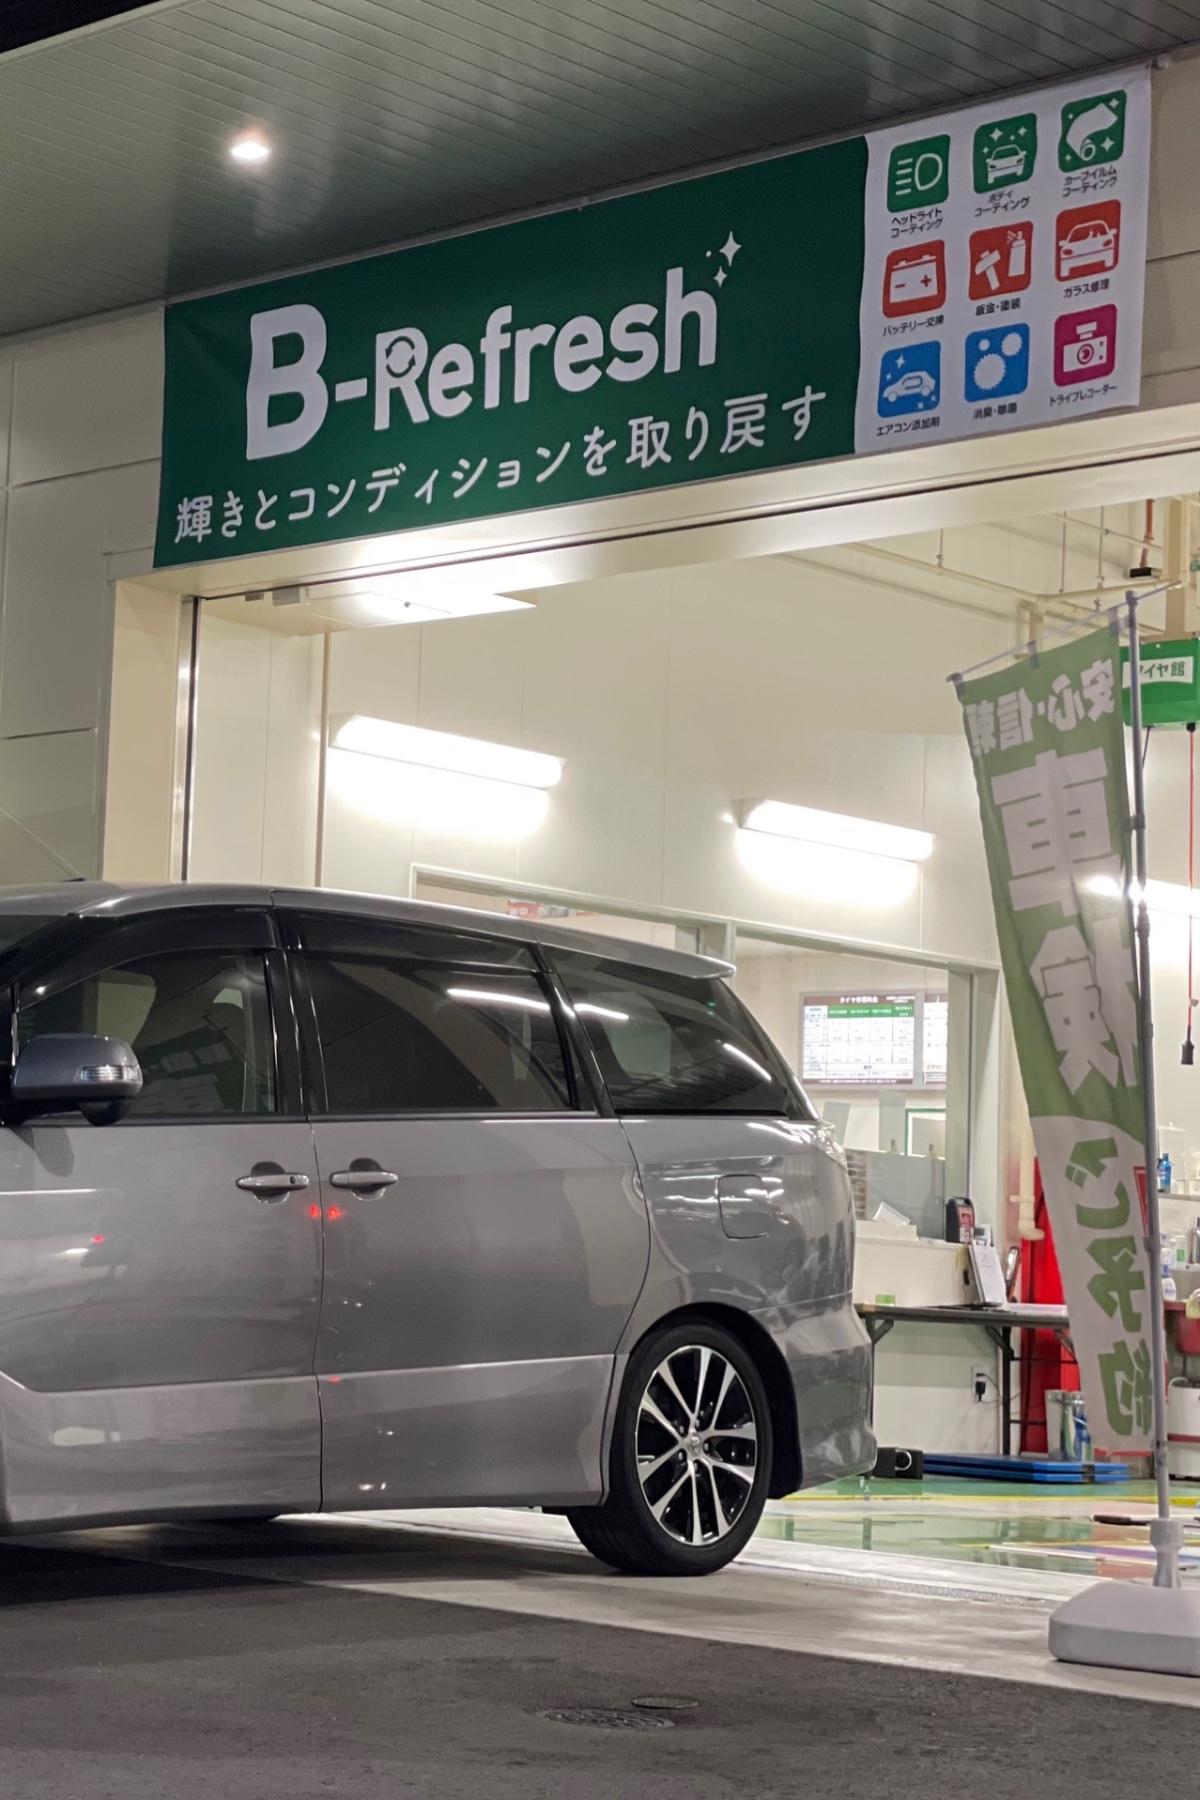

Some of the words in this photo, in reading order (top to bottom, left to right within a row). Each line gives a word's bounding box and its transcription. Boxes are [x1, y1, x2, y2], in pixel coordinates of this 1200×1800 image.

[891, 207, 942, 225] ヘッドライト
[973, 195, 1030, 217] コーティング
[890, 217, 943, 238] コーティング
[1063, 278, 1110, 297] ガラス修理
[882, 315, 944, 336] バッテリー交換
[246, 266, 718, 461] B-Refresh
[972, 403, 1018, 419] 消臭・除菌
[876, 416, 940, 436] エアコン添加剤
[174, 386, 826, 544] 輝きとコンディションを取り戻す
